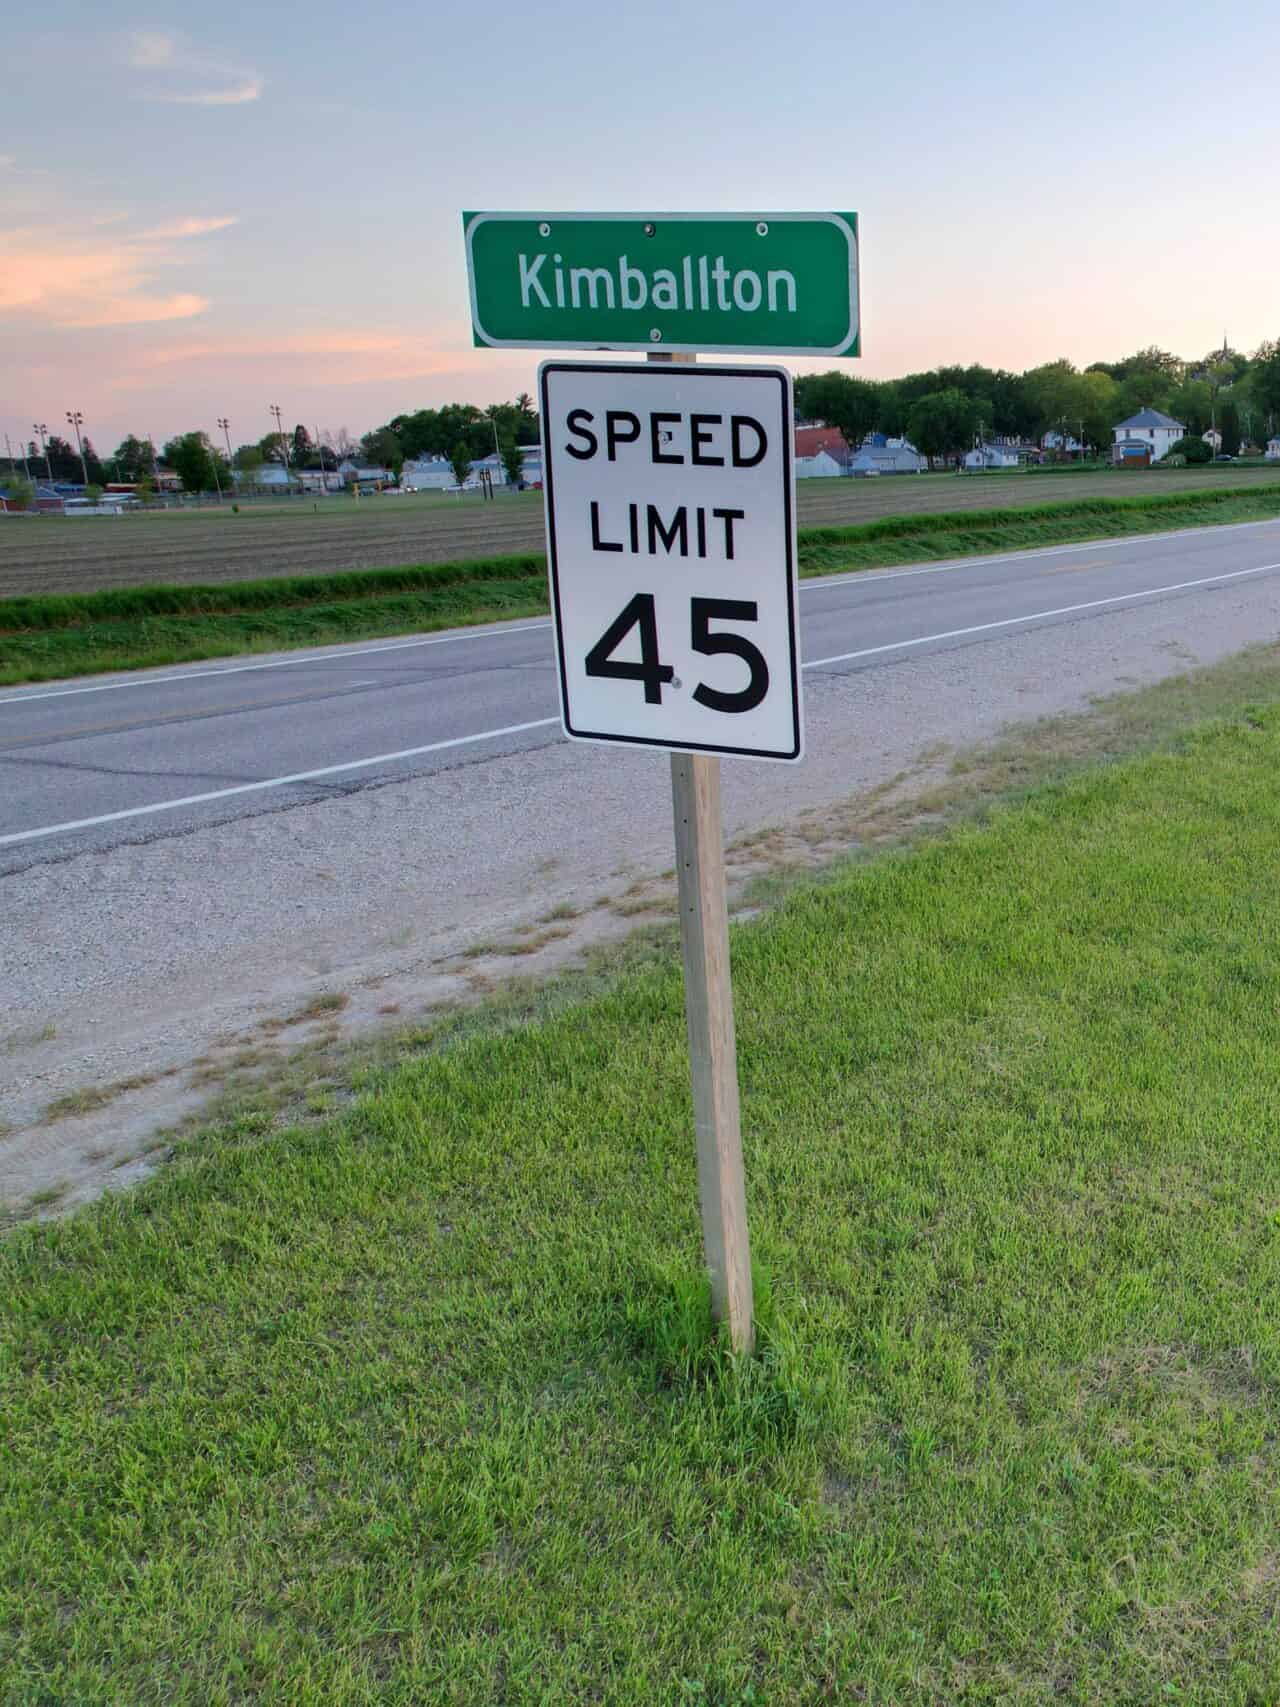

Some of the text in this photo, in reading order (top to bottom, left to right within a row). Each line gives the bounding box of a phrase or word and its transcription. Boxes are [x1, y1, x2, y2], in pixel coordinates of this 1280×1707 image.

[517, 253, 798, 312] Kimballton
[565, 409, 769, 468] SPEED
[591, 501, 745, 560] LIMIT
[585, 593, 770, 714] 45
